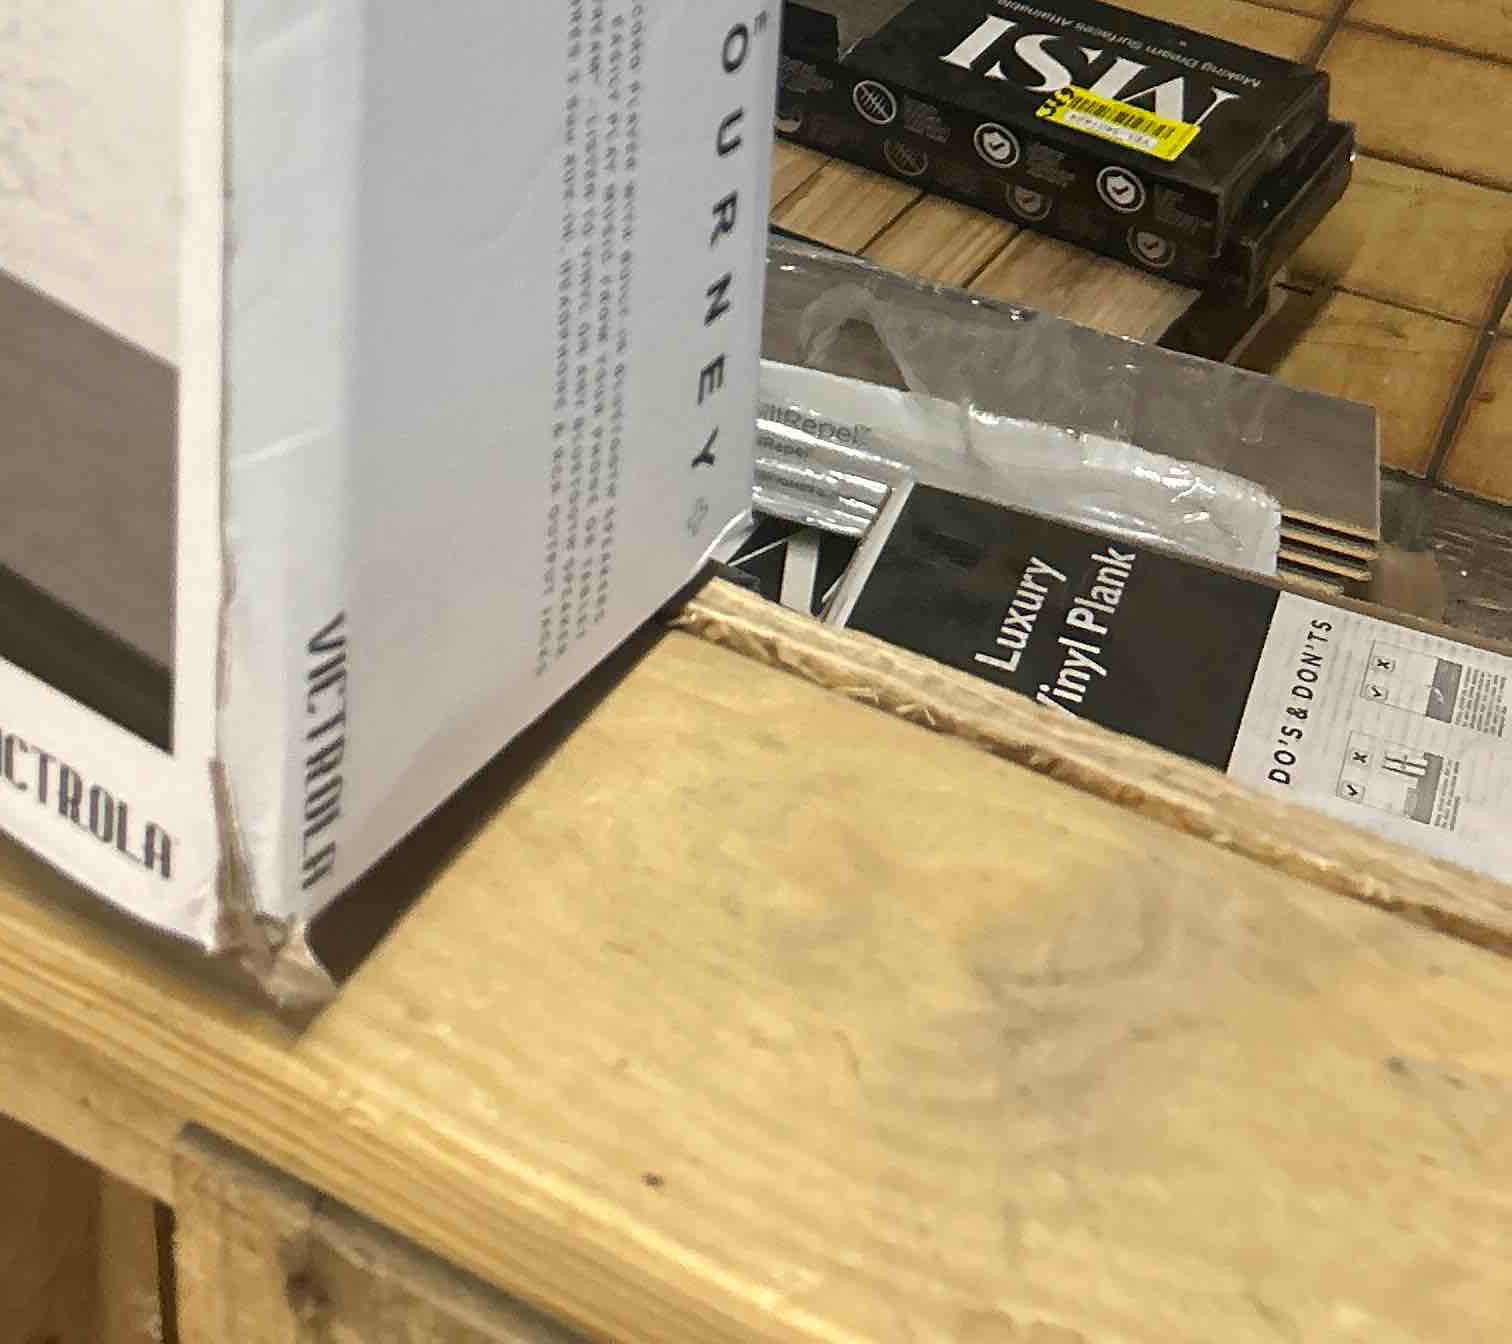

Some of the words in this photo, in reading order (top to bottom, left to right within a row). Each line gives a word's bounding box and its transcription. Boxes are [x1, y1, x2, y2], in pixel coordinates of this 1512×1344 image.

[974, 556, 1067, 672] Luxury
[1065, 547, 1136, 635] Plank
[1291, 619, 1333, 700] DON'TS
[300, 610, 346, 890] VICTROLA
[1268, 725, 1303, 785] DO'S
[1286, 707, 1309, 720] &
